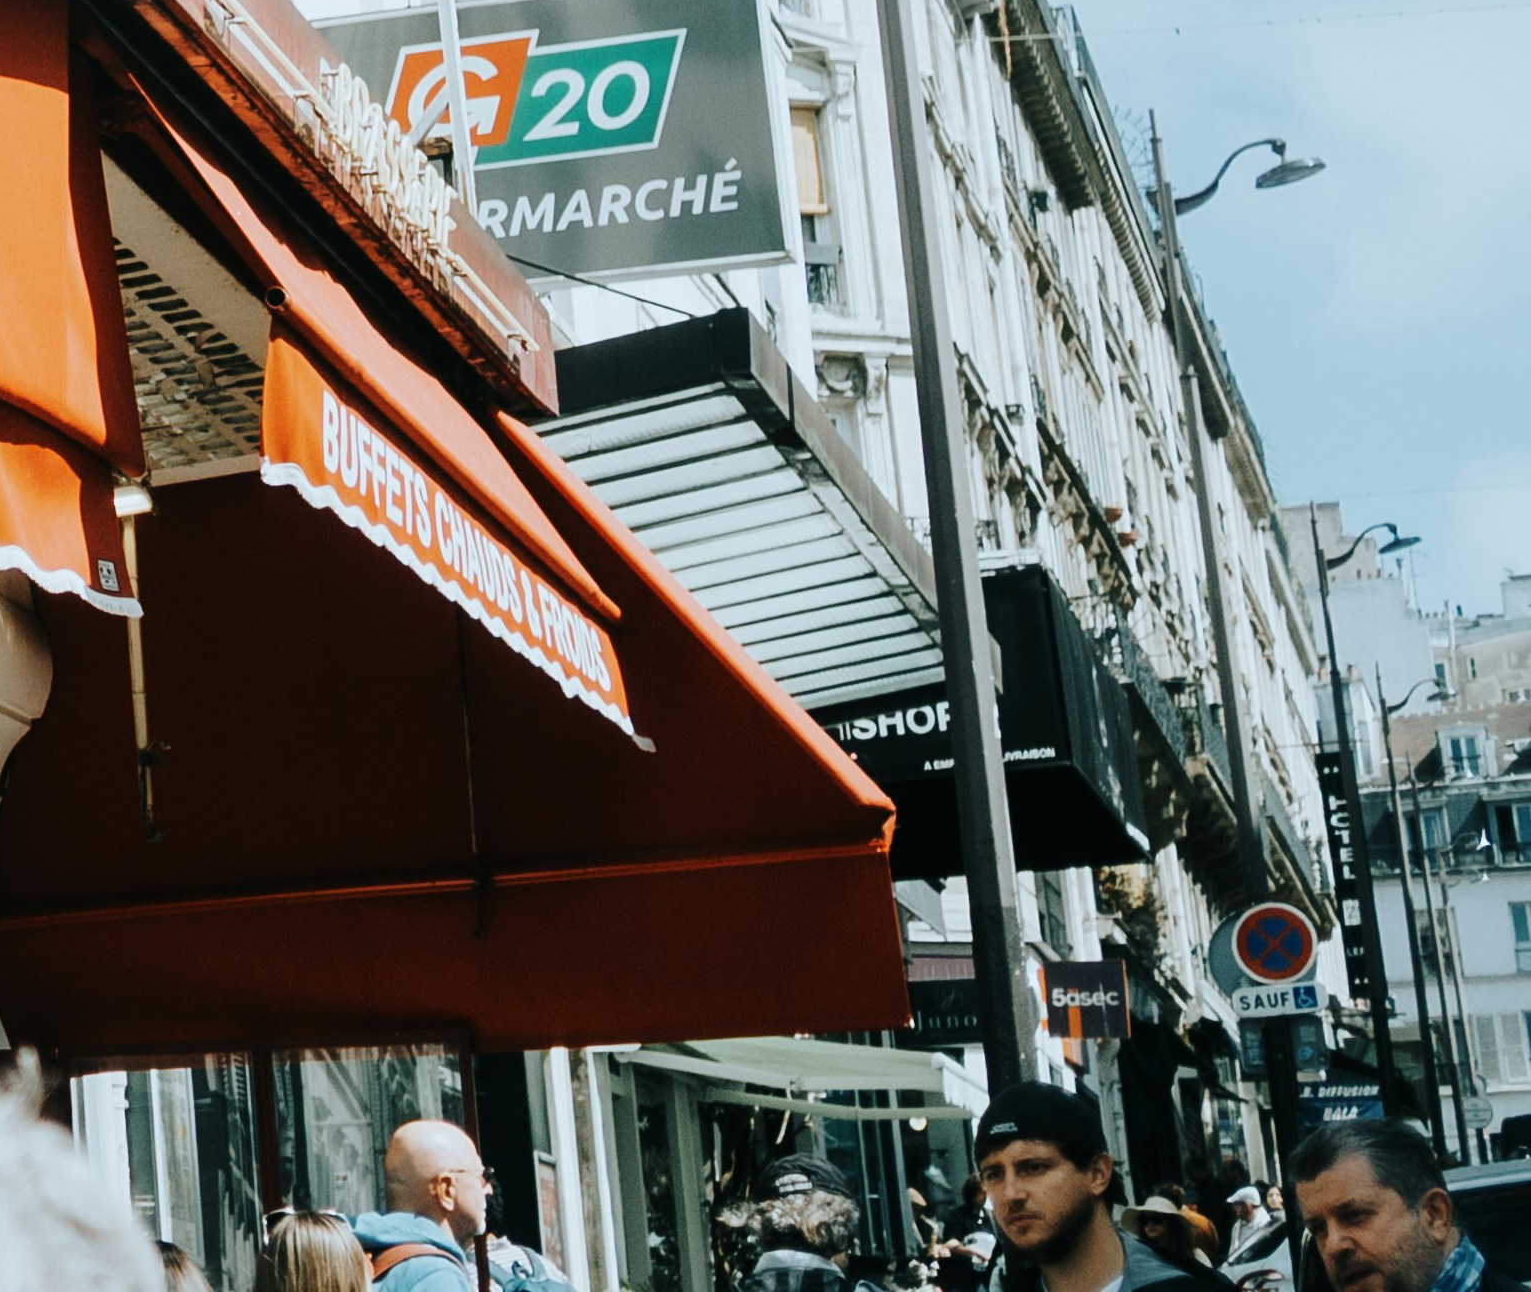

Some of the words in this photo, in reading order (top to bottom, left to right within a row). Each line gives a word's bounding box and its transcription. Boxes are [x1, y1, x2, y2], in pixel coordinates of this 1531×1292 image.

[479, 157, 742, 239] RMARCHÉ
[322, 389, 432, 549] BUFFETS
[434, 490, 524, 625] CHAUDS
[519, 569, 543, 640] &
[536, 581, 612, 693] FROIDS
[916, 1010, 978, 1036] Juno
[1240, 991, 1290, 1011] SAUF
